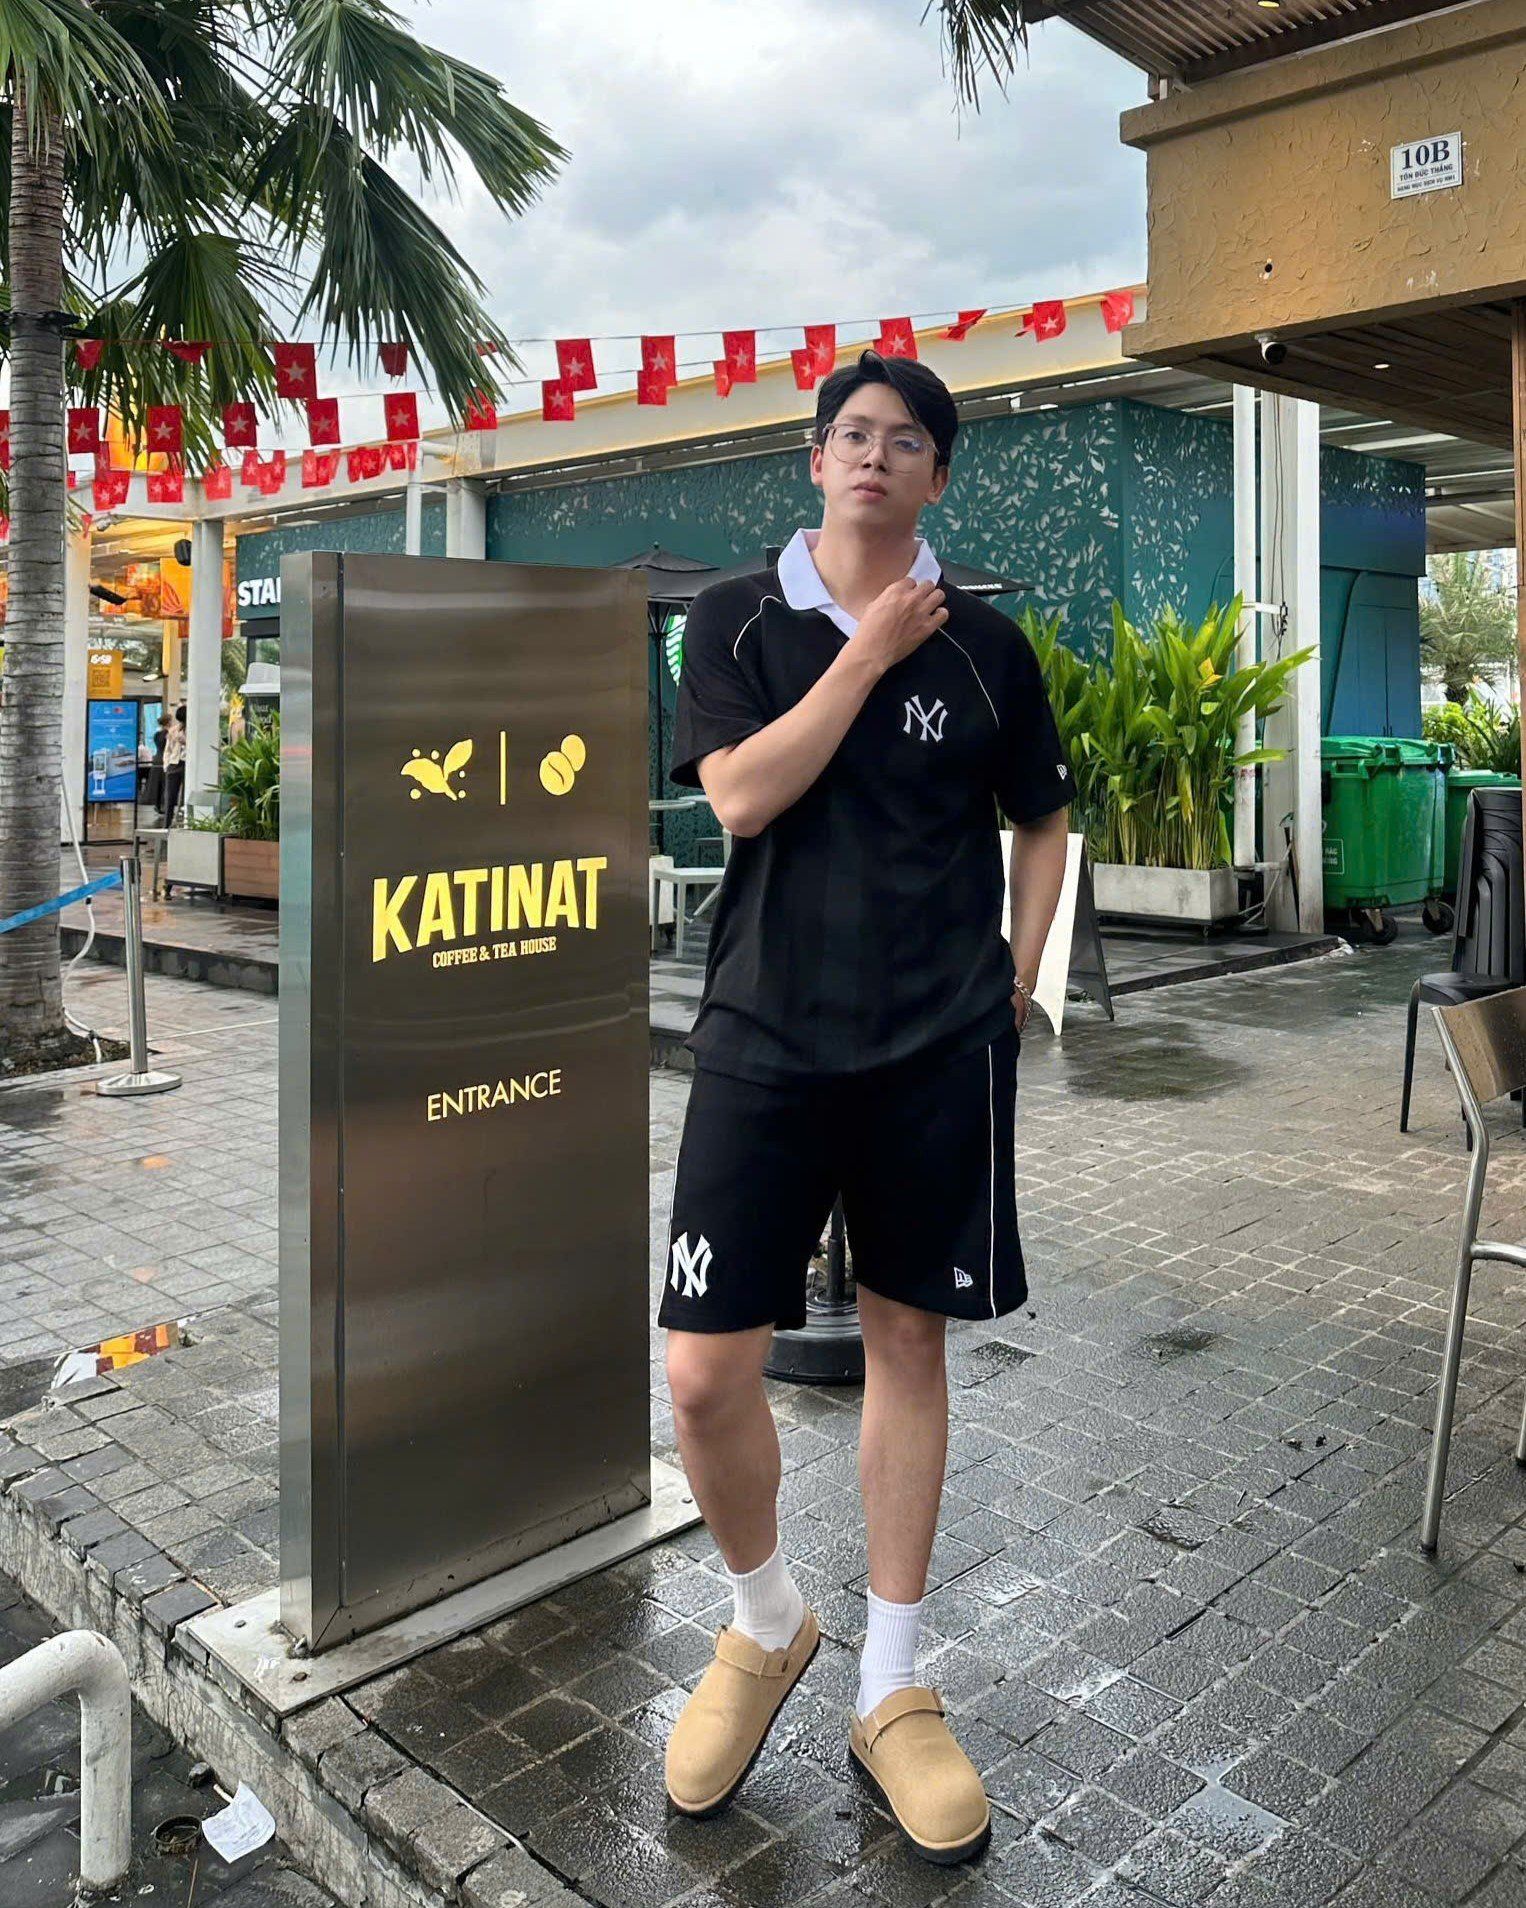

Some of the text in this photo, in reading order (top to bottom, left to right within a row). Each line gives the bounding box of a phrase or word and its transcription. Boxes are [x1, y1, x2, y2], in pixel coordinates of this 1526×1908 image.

[1400, 172, 1413, 181] TÔN
[1402, 140, 1450, 170] 10B
[903, 695, 949, 743] NY
[372, 857, 607, 963] KATINAT
[432, 936, 557, 968] COFFEE & TEA HOUSE
[427, 1069, 561, 1121] ENTRANCE
[670, 1231, 714, 1298] NY
